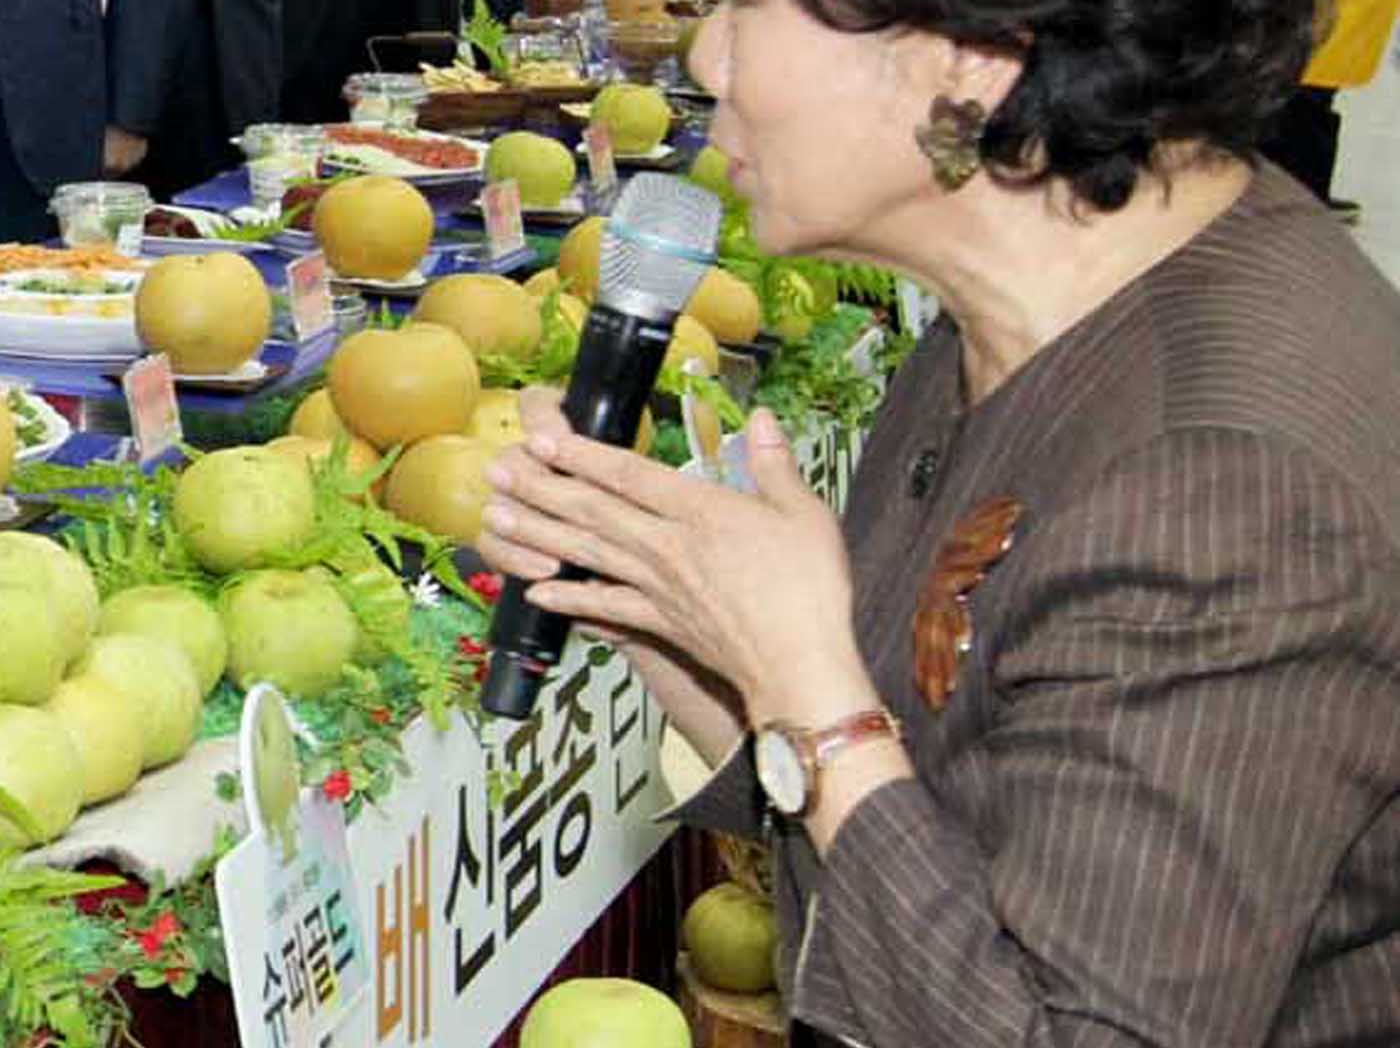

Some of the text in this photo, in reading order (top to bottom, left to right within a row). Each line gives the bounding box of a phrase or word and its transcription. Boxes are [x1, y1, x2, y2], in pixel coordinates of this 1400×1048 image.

[264, 889, 355, 1048] 슈퍼골드
[376, 812, 430, 1045] 배
[444, 664, 597, 996] 신품종
